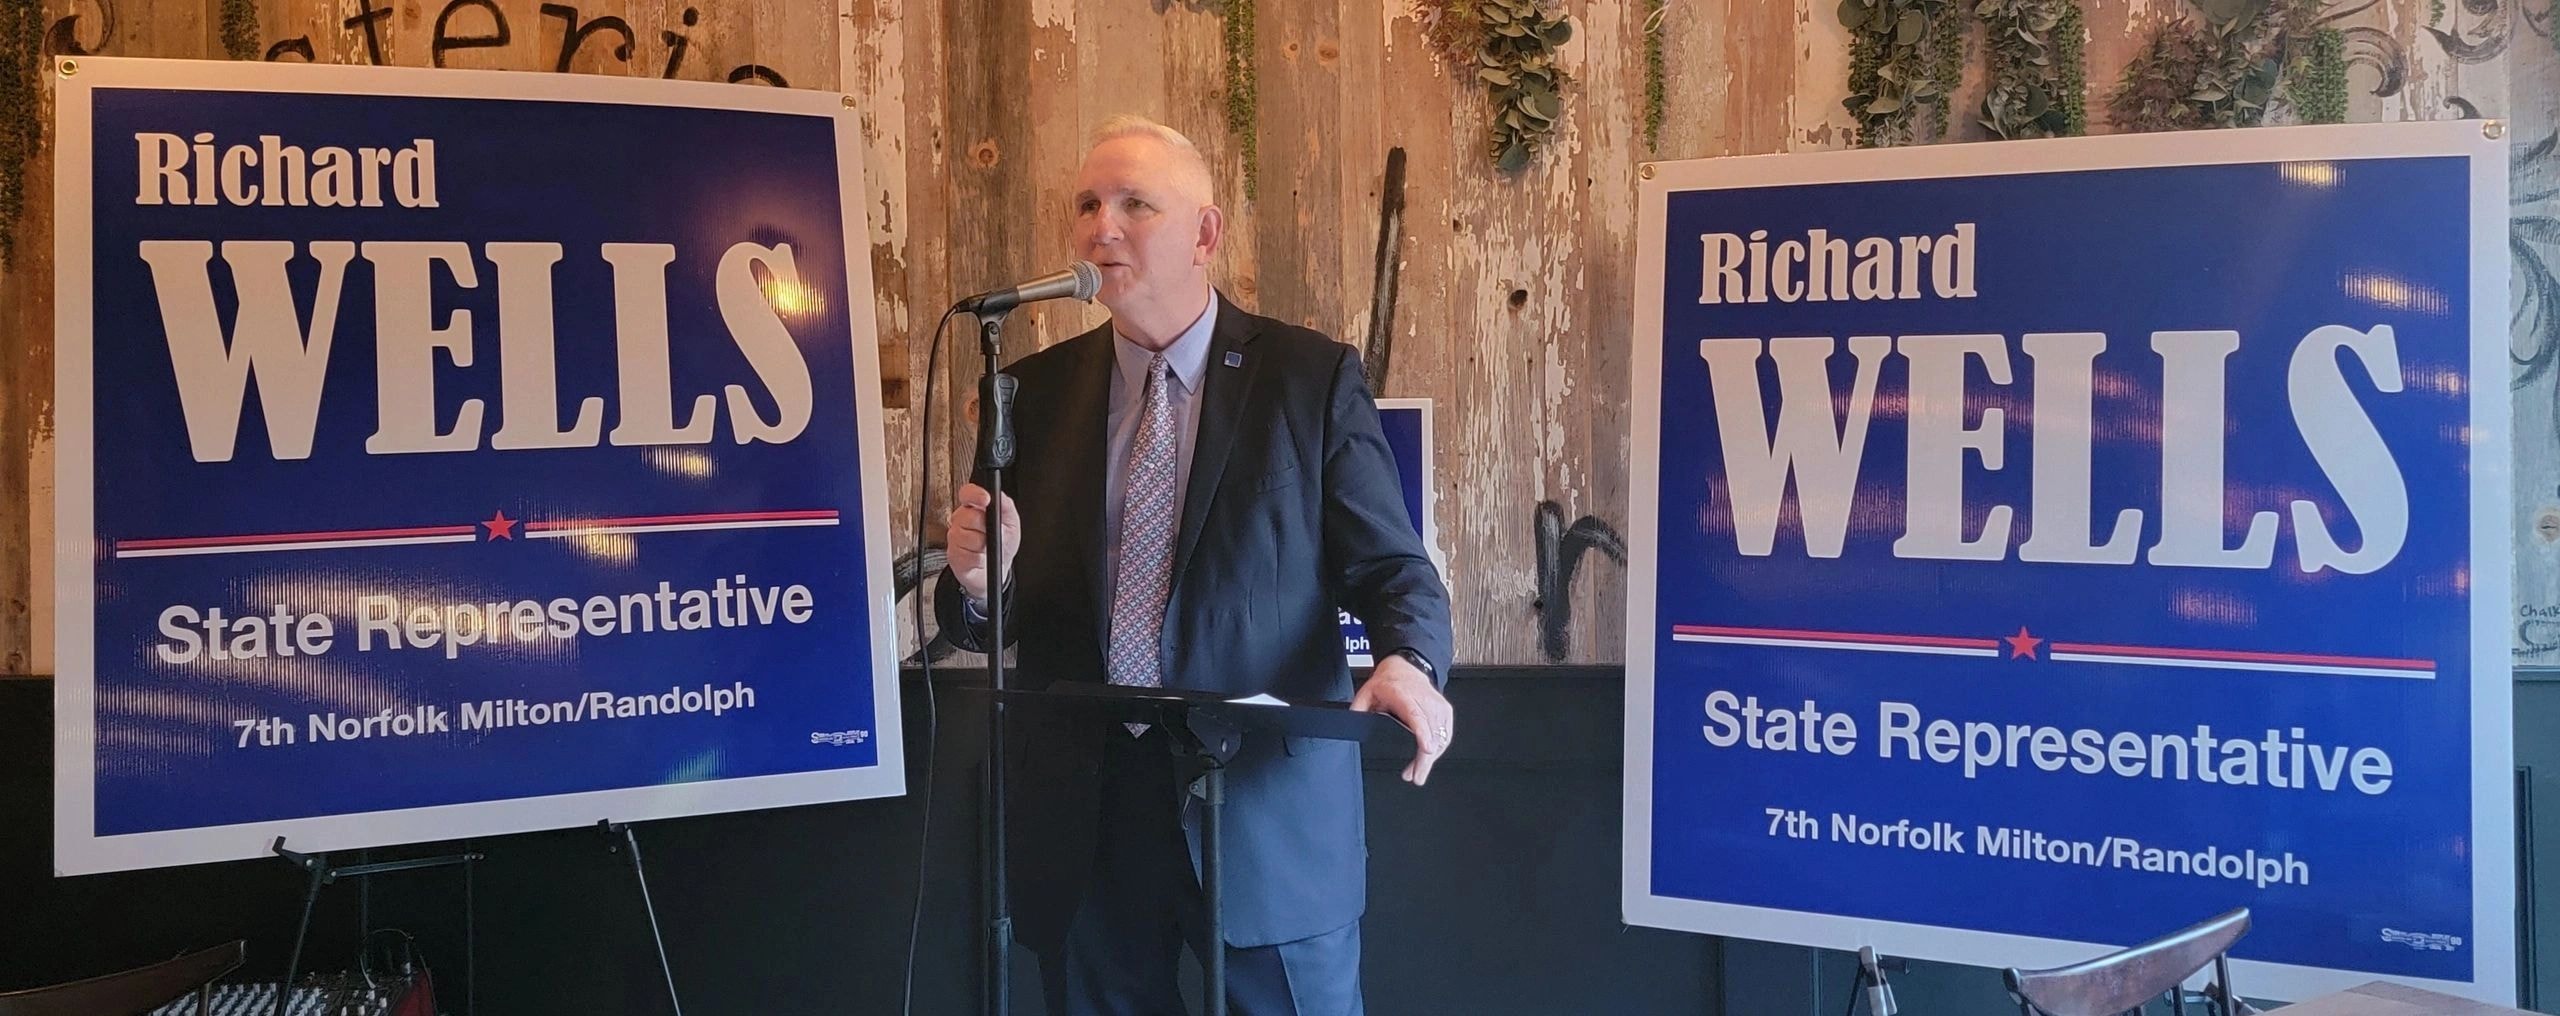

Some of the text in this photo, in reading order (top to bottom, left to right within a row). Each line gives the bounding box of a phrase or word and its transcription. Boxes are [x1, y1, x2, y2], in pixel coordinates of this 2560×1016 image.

[135, 132, 440, 208] Richard
[1699, 222, 1978, 304] Richard
[140, 240, 816, 463] WELLS
[1700, 324, 2409, 575] WELLS
[156, 574, 815, 664] State Representative
[233, 681, 755, 748] 7th Norfolk Milton/Randolph
[1702, 690, 2394, 795] State Representative
[1765, 807, 2310, 889] 7th Norfolk Milton/Randolph
